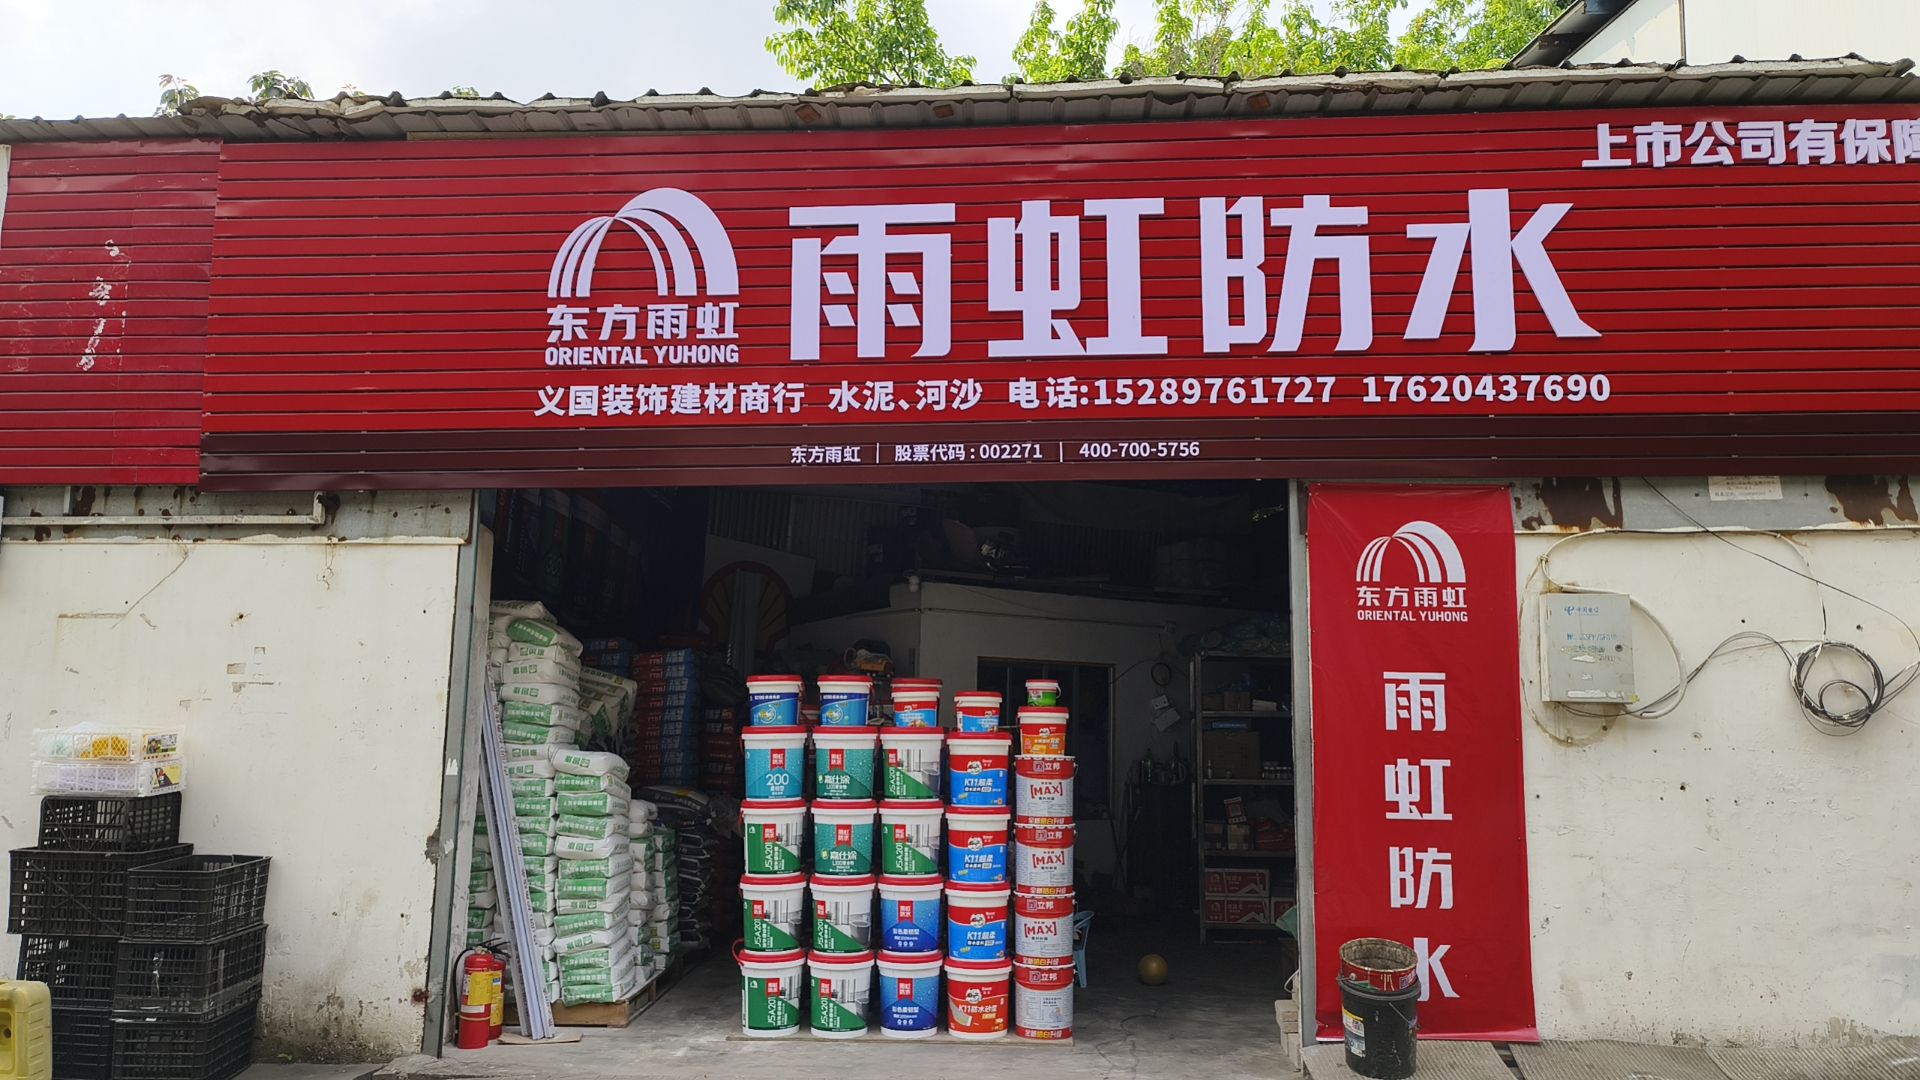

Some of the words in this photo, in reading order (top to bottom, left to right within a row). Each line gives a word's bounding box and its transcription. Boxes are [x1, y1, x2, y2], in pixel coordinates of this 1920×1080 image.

[788, 188, 1602, 361] 雨虹防水
[546, 302, 740, 343] 东方雨虹
[545, 346, 648, 366] ORIENTAL
[655, 343, 740, 365] YUHONG
[534, 382, 805, 417] 义国装饰建材商行
[829, 378, 984, 413] 水泥、河沙
[1009, 376, 1336, 410] 电话:15289761727
[1363, 374, 1612, 403] 17620437690
[790, 446, 862, 465] 东方雨虹
[894, 443, 1044, 463] 股票代码:002271
[1079, 441, 1201, 459] 400-700-5756
[1356, 585, 1468, 609] 东方雨虹
[1357, 610, 1416, 622] ORIENTAL
[1420, 610, 1469, 623] YUHONG
[766, 773, 789, 786] 200
